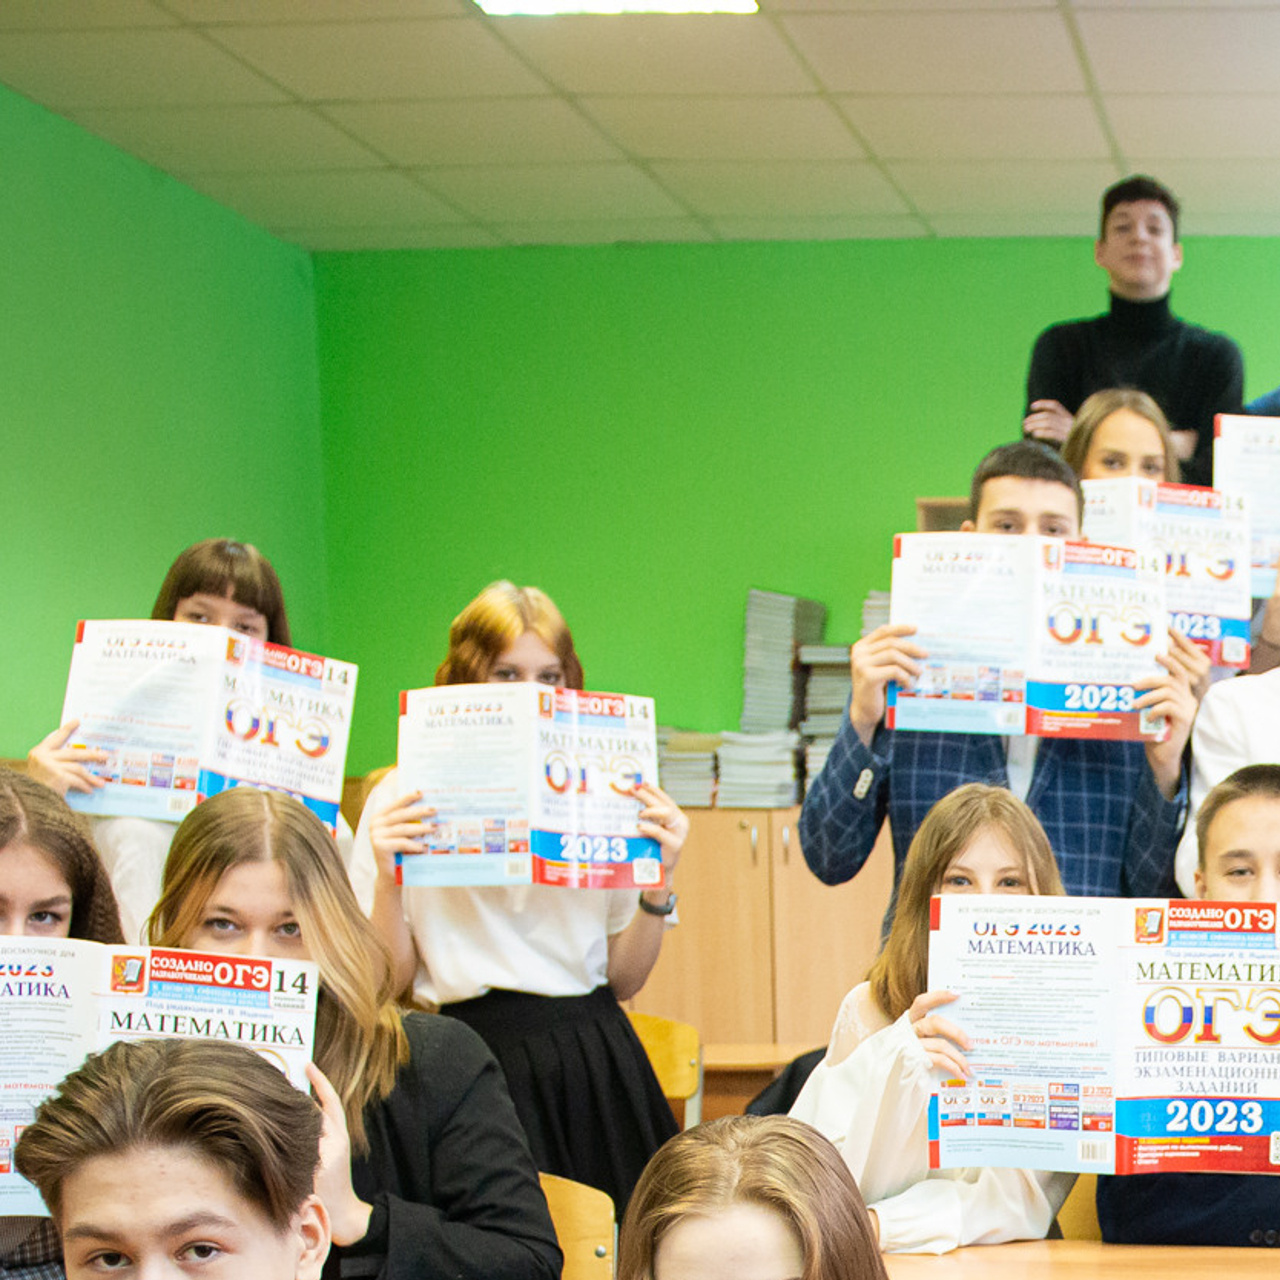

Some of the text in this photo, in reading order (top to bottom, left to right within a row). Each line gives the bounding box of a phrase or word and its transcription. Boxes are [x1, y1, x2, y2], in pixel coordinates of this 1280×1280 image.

[1047, 602, 1153, 646] ОГЭ
[286, 654, 325, 677] ОГЭ
[326, 665, 348, 684] 14
[590, 698, 625, 715] ОГЭ
[1064, 685, 1135, 712] 2023
[629, 702, 649, 719] 14
[225, 699, 332, 758] ОГЭ
[544, 750, 644, 797] ОГЭ
[560, 835, 628, 862] 2023
[1170, 908, 1223, 920] СОЗДАНО
[1224, 908, 1275, 929] ОГЭ
[1027, 921, 1082, 936] 2023
[969, 940, 1097, 956] МАТЕМАТИКА
[152, 956, 213, 972] СОЗДАНО
[213, 962, 270, 988] ОГЭ
[274, 969, 309, 994] 14
[110, 1011, 305, 1046] МАТЕМАТИКА
[1135, 1051, 1210, 1063] ТИПОВЫЕ
[1177, 1080, 1258, 1094] ЗАДАНИЙ
[1166, 1100, 1263, 1133] 2023
